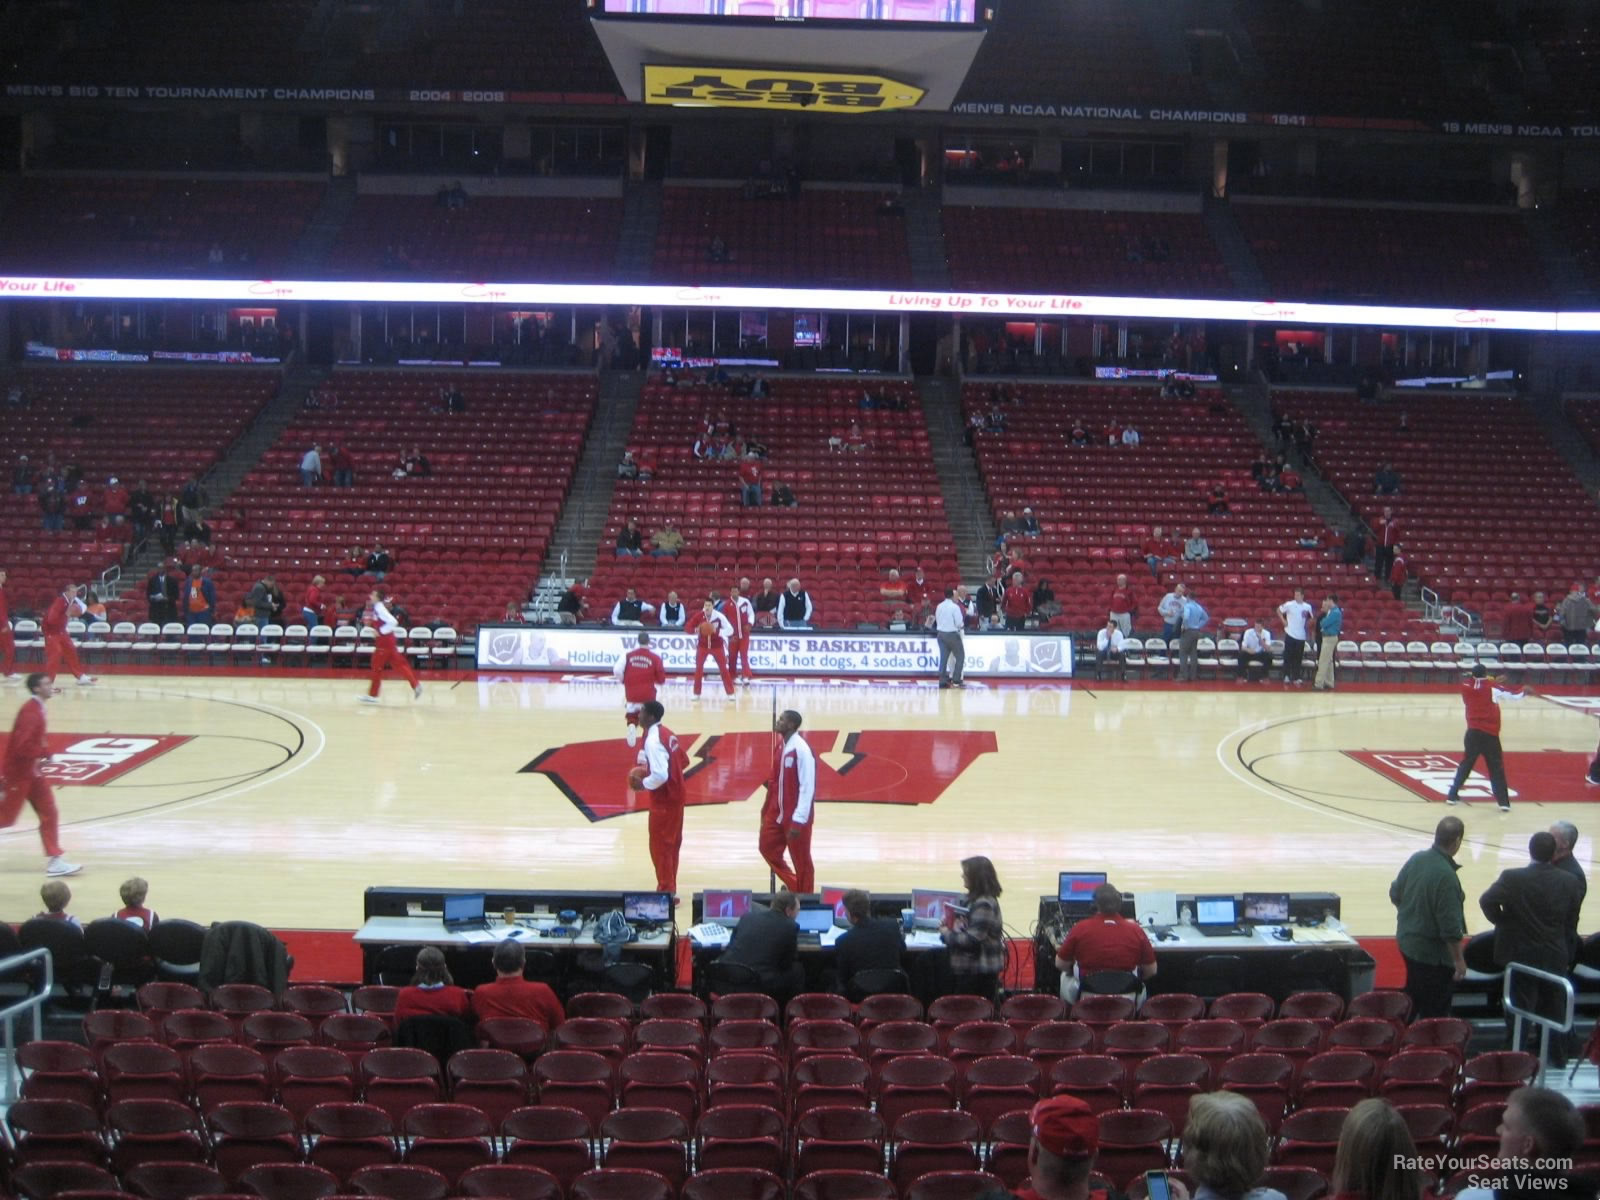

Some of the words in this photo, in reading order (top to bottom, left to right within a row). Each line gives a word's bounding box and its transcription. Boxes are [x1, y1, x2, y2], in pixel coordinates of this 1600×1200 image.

[674, 74, 884, 95] BUY
[6, 85, 63, 97] MEN'S
[69, 86, 99, 98] BIG
[105, 87, 139, 98] TEN
[146, 87, 270, 99] TOURNAMENT
[273, 88, 375, 101] CHAMPIONS
[409, 90, 451, 101] 2004
[650, 87, 886, 107] BEST
[952, 103, 1005, 115] MEN'S
[1010, 104, 1057, 117] NCAA
[1060, 106, 1142, 120] NATIONAL
[1149, 109, 1247, 123] CHAMPIONS
[1271, 114, 1306, 127] 1941
[1464, 123, 1513, 136] MEN'S
[1518, 124, 1563, 137] NCAA
[0, 279, 38, 292] Your
[43, 280, 77, 292] Life
[888, 294, 943, 308] Living
[947, 296, 973, 309] Up
[980, 296, 999, 308] To
[1006, 297, 1046, 309] Your
[1050, 298, 1083, 310] Life
[806, 639, 932, 654] BASKETBALL
[567, 650, 620, 665] Holiday
[779, 654, 788, 666] 4
[792, 653, 816, 667] hot
[820, 654, 856, 670] dogs,
[860, 655, 869, 667] 4
[873, 655, 913, 668] sodas
